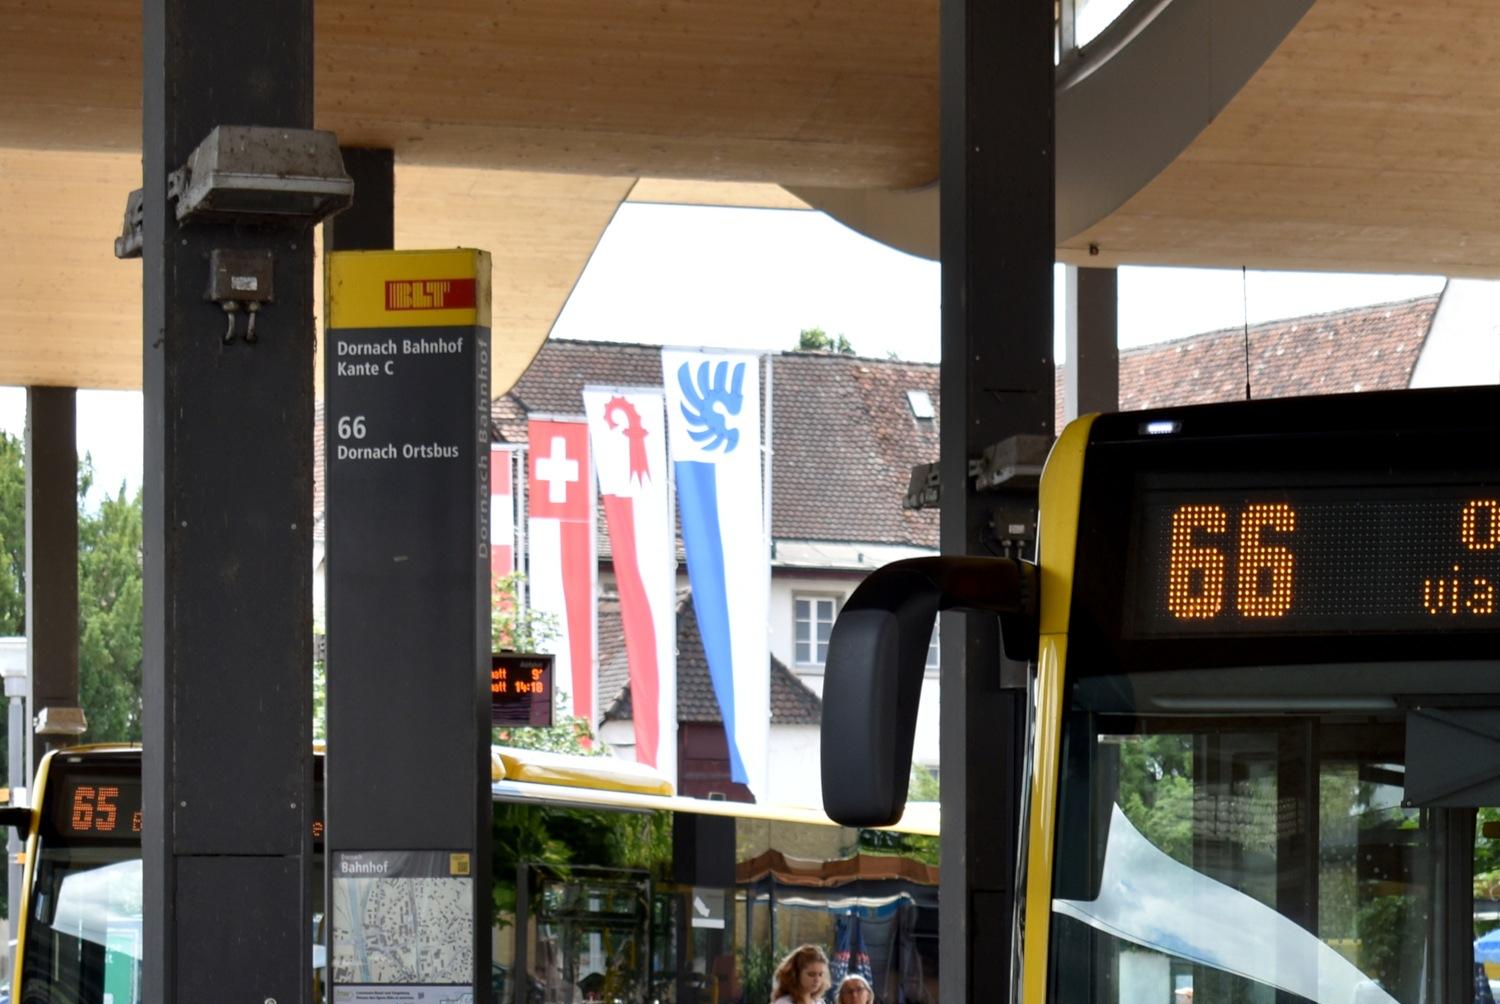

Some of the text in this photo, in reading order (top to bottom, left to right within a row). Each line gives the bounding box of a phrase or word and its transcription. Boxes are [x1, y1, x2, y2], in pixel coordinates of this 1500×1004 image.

[389, 282, 451, 309] BLT
[337, 337, 463, 356] Dornach Bahnhof
[337, 360, 394, 377] Kante C
[337, 415, 367, 439] 66
[337, 442, 459, 460] Dornach Ortsbus
[478, 339, 489, 559] Dornach Bahnhof
[1166, 503, 1296, 620] 66
[1422, 564, 1494, 615] via
[72, 786, 119, 831] 65
[341, 860, 389, 874] Bahnhof
